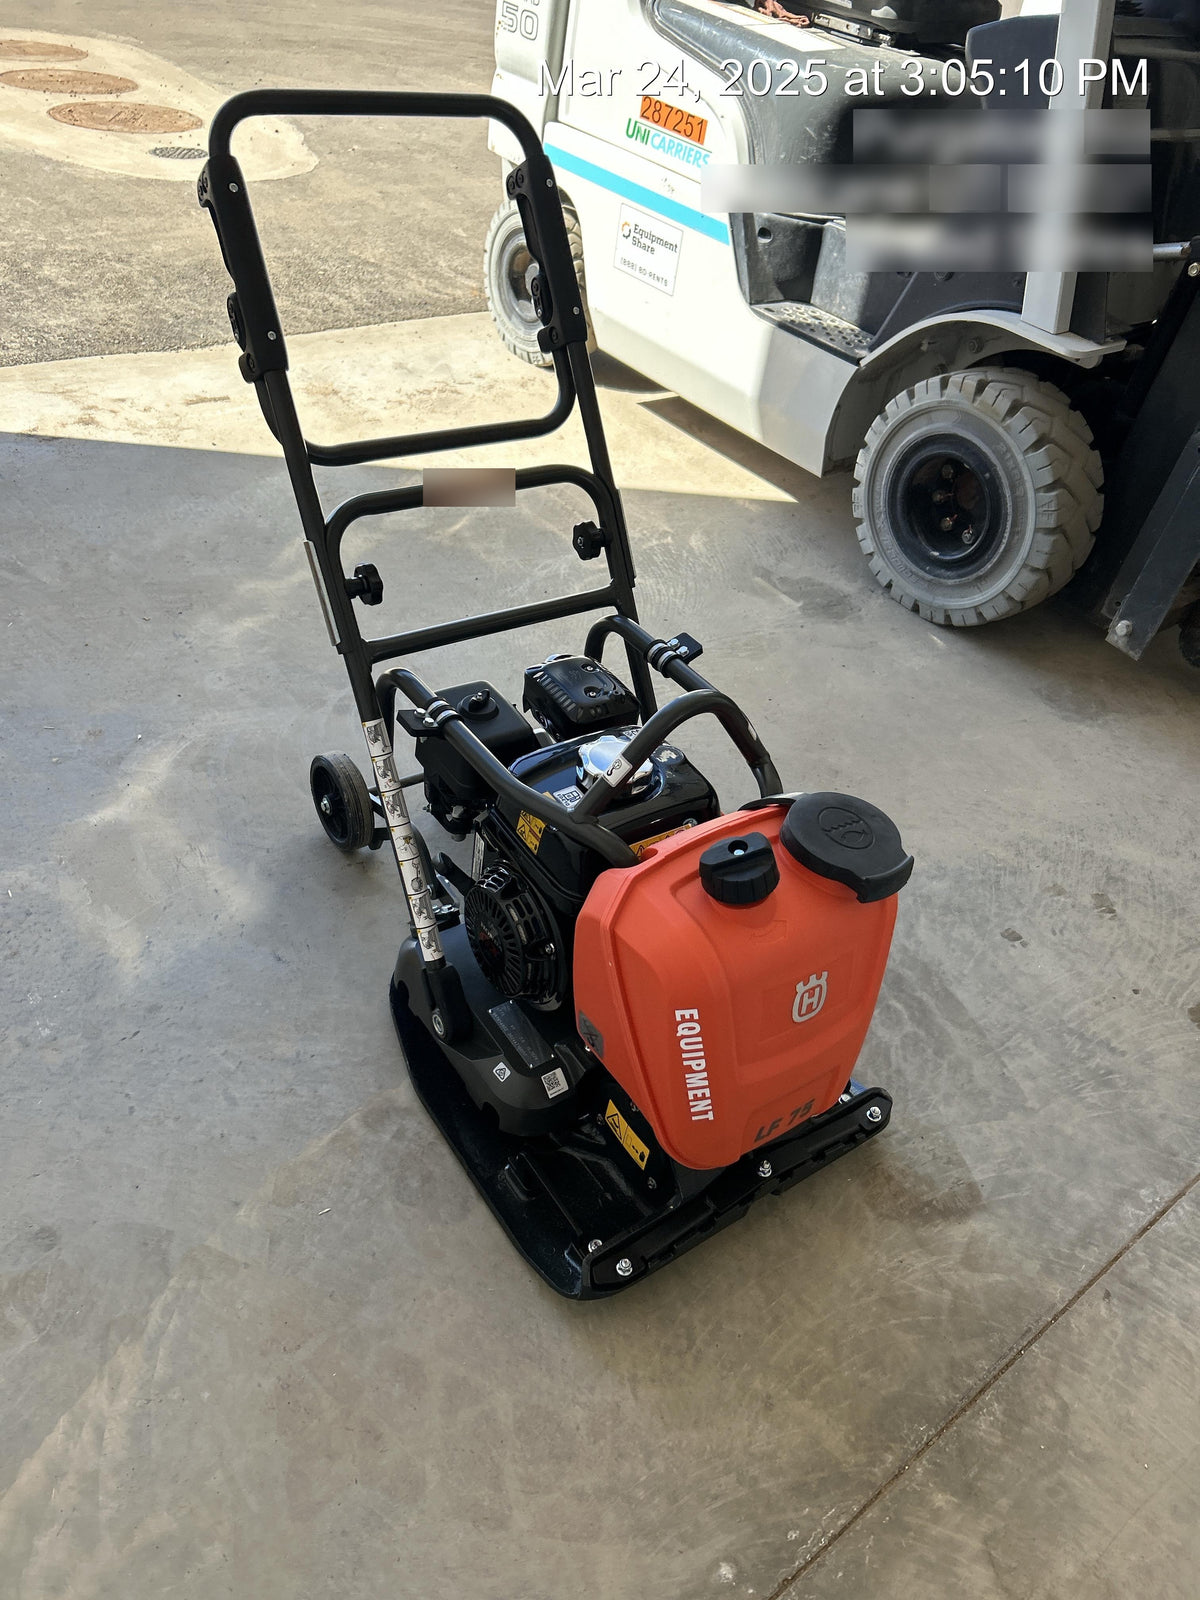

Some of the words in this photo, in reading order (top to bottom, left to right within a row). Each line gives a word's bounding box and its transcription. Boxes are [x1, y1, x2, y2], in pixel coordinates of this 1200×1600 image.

[501, 1, 539, 41] 50
[640, 96, 705, 143] 287251
[631, 235, 656, 255] Share
[633, 223, 678, 253] Equipment
[674, 1008, 714, 1121] EQUIPMENT
[754, 1116, 784, 1143] LF
[787, 1097, 816, 1126] 75
